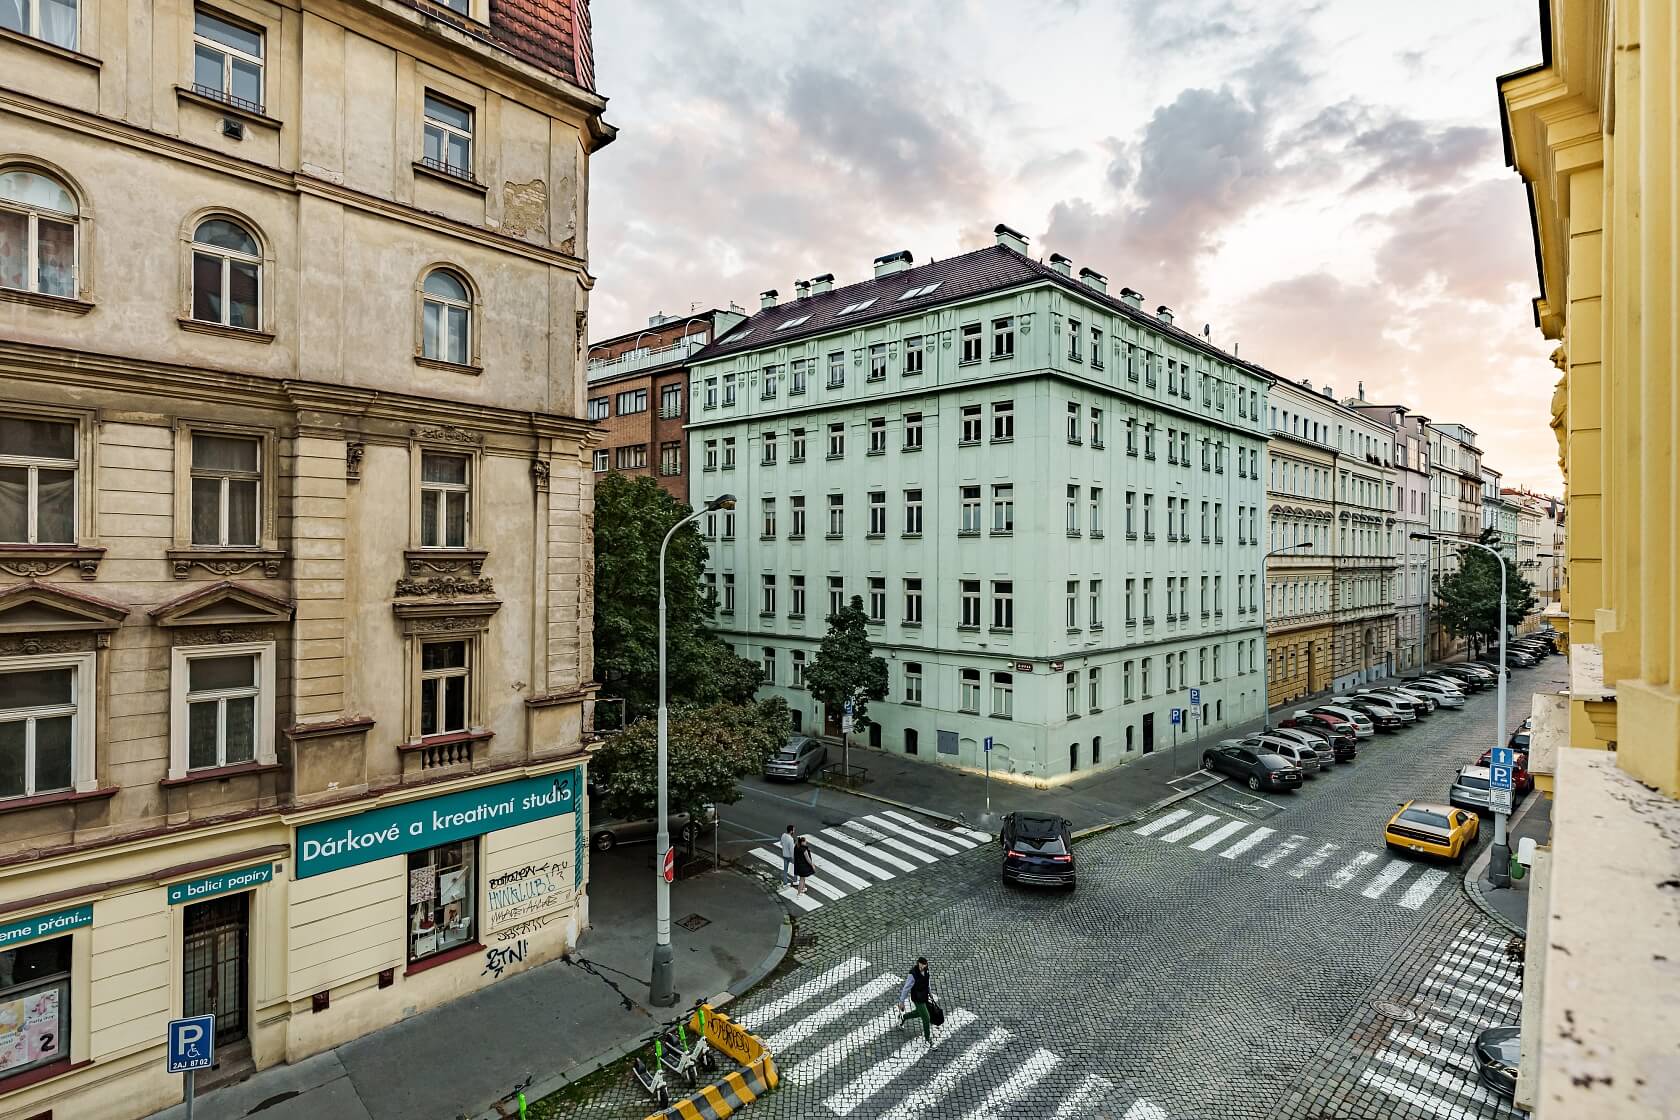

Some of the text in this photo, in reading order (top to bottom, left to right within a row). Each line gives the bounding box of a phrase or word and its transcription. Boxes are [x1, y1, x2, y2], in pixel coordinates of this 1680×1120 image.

[1494, 767, 1507, 781] P
[302, 823, 400, 862] Dárkové
[409, 819, 423, 836] a
[432, 797, 515, 831] kreativní
[172, 869, 269, 900] a balicí papíry
[38, 912, 91, 934] přání...
[39, 1033, 55, 1052] 2
[178, 1025, 203, 1055] P
